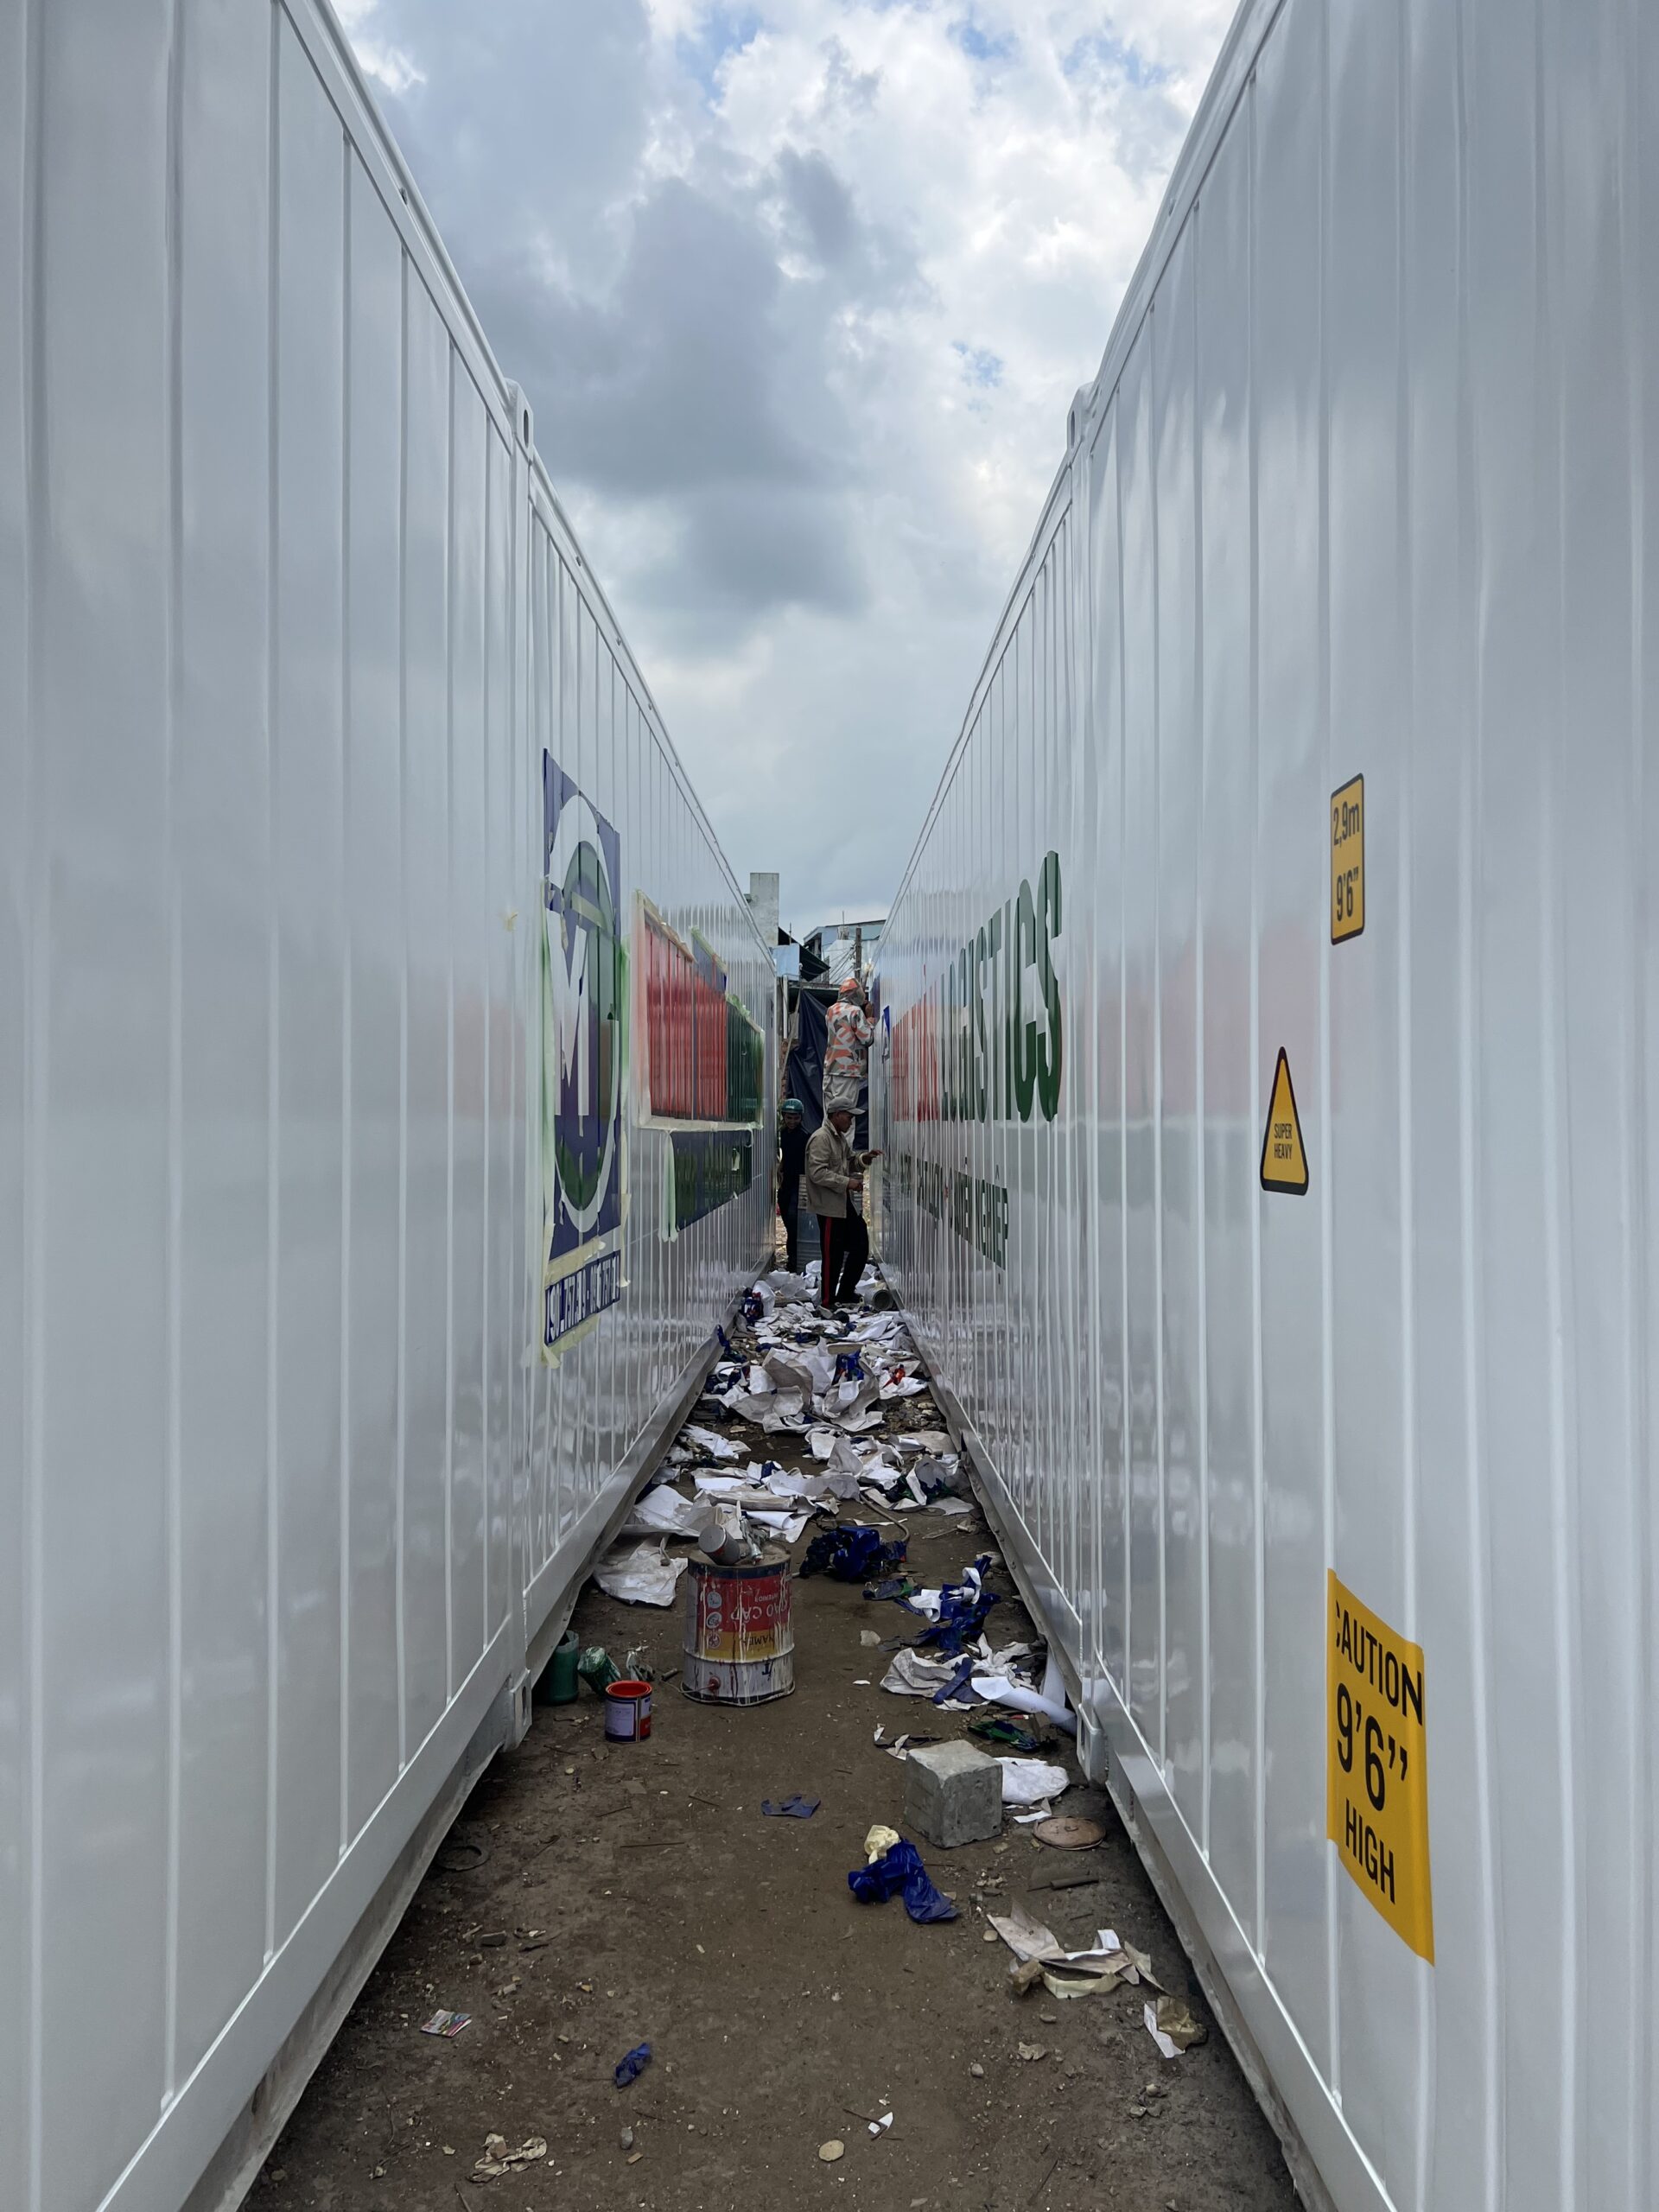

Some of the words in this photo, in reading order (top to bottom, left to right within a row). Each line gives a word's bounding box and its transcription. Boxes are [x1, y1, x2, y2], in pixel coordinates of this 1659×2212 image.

[941, 850, 1062, 1123] LOGISTICS
[1274, 1123, 1293, 1139] SUPER
[1274, 1143, 1293, 1160] HEAVY
[1345, 1797, 1395, 1904] HIGH
